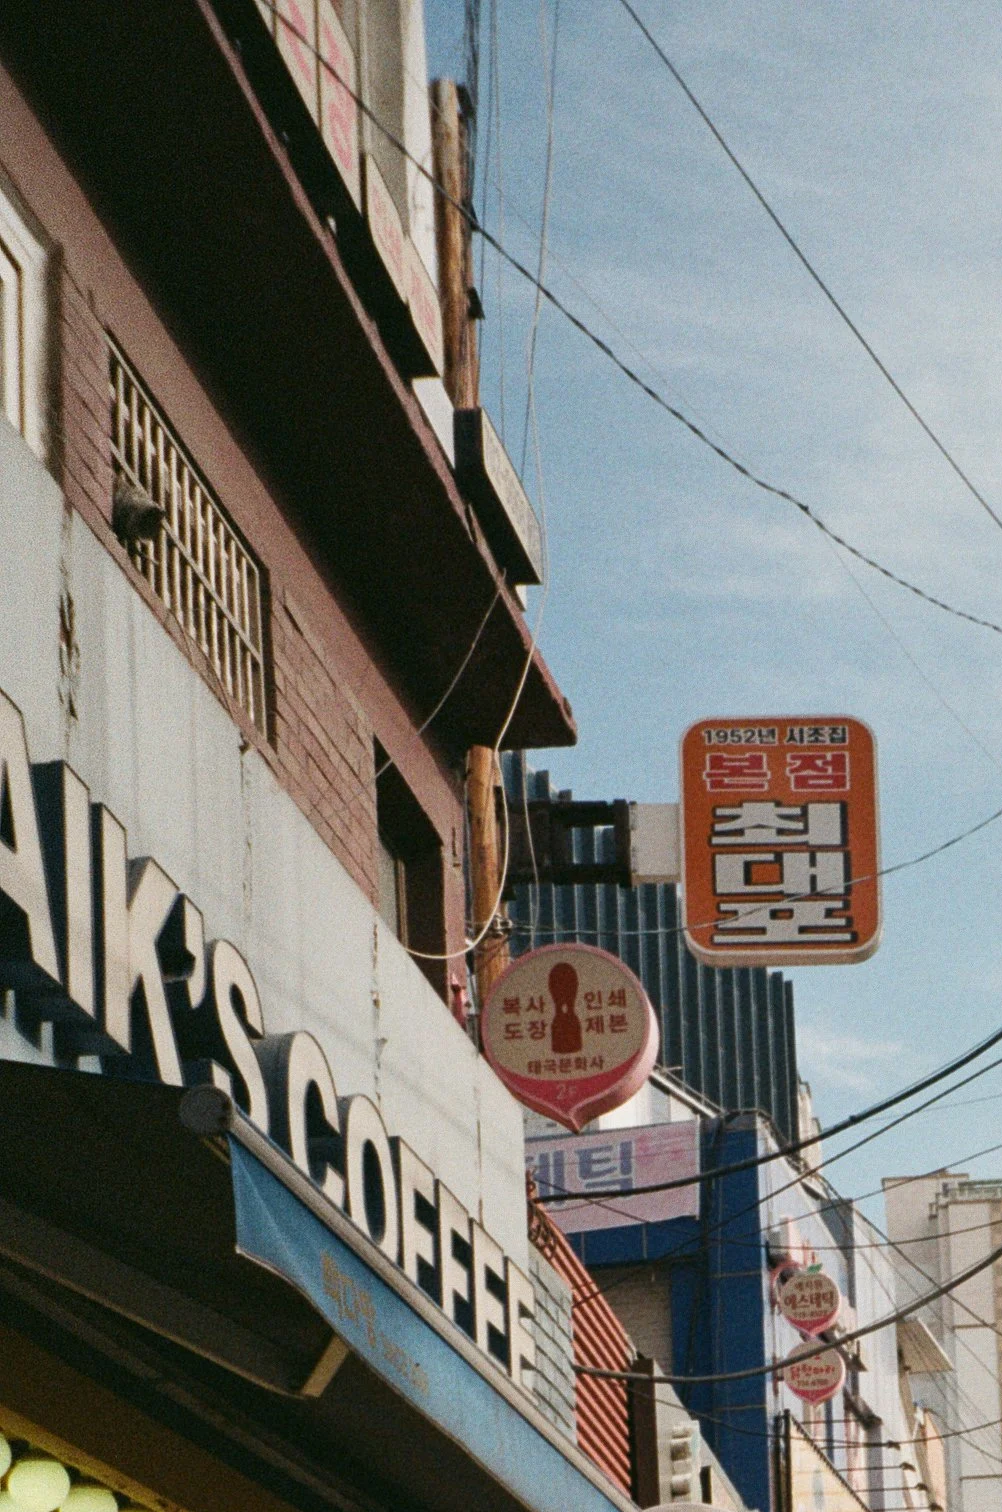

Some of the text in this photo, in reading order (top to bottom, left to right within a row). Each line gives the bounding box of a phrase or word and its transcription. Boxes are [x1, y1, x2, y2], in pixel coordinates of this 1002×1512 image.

[704, 725, 849, 746] 1952년 시조집
[703, 752, 850, 792] 본점
[709, 800, 859, 945] 최대포
[503, 996, 546, 1016] 복사
[583, 988, 628, 1009] 인쇄
[503, 1020, 548, 1040] 도장
[585, 1014, 629, 1035] 제본
[286, 1030, 536, 1388] COFFEE
